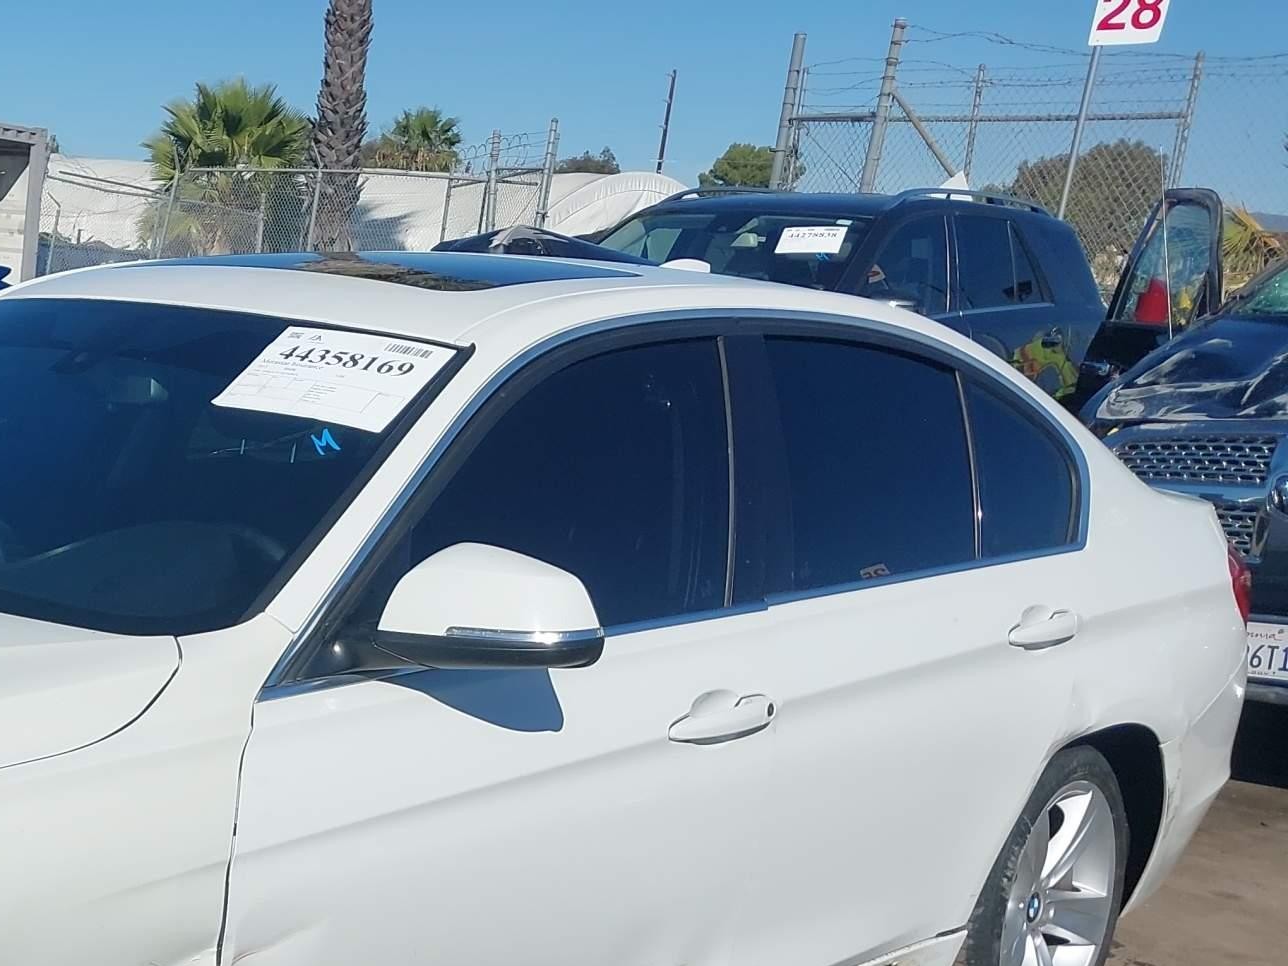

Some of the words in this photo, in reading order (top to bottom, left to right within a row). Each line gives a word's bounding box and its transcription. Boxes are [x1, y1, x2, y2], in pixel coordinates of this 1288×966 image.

[1096, 0, 1162, 31] 28
[279, 345, 415, 377] 44358169
[1247, 644, 1288, 672] 6T1
